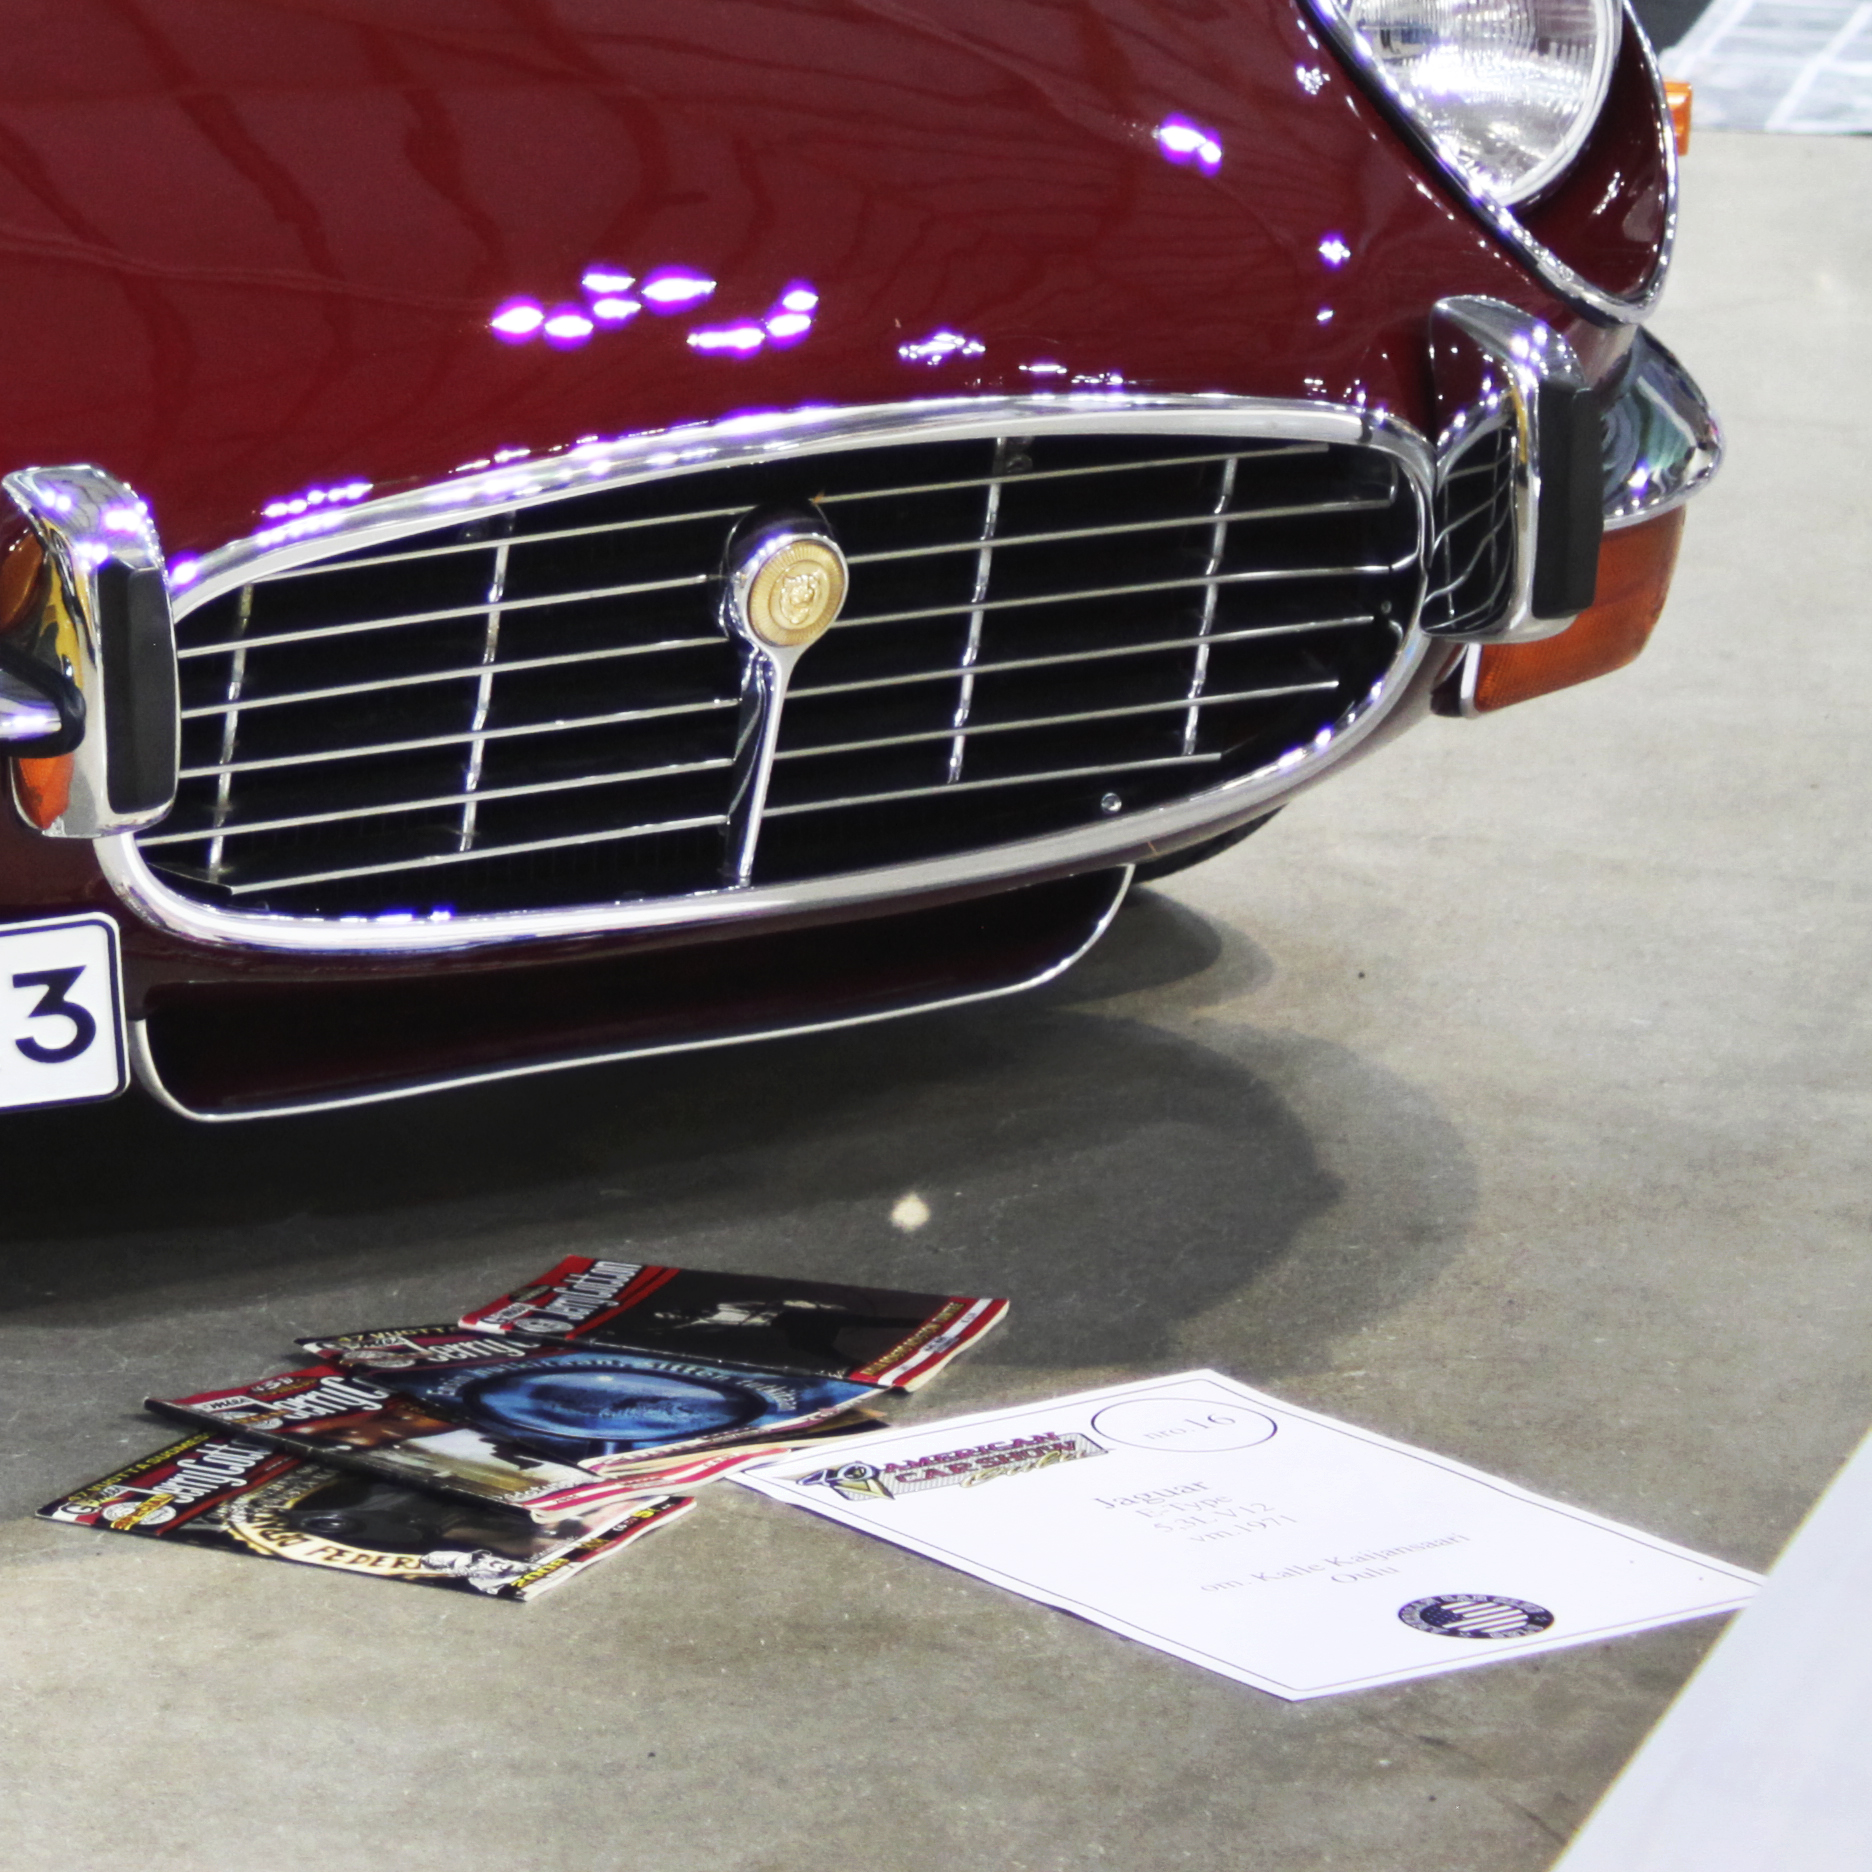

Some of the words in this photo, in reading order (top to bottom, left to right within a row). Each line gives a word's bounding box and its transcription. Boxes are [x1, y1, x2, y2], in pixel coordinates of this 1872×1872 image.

[885, 1431, 1061, 1473] AMERICAN
[897, 1461, 974, 1484] CAR
[976, 1440, 1077, 1471] SHOW
[1092, 1479, 1212, 1511] Jaguar
[1135, 1494, 1234, 1520] E-Type
[305, 1544, 421, 1570] FEDER
[1330, 1564, 1402, 1585] Oulu
